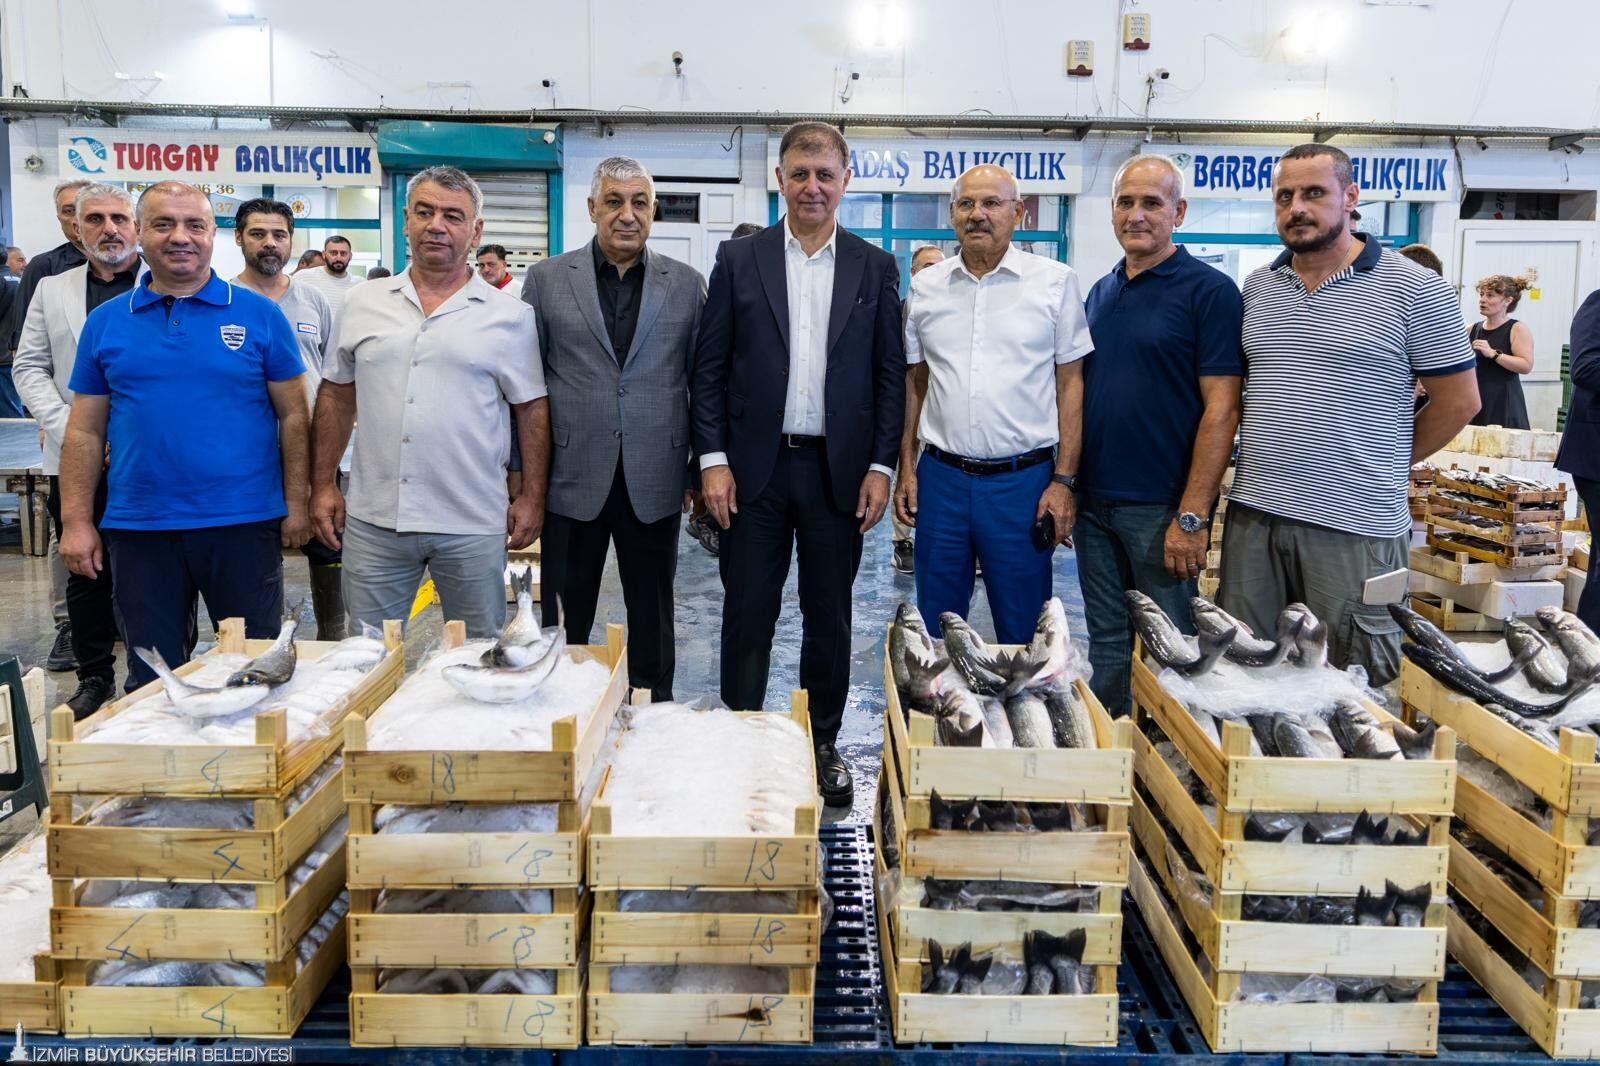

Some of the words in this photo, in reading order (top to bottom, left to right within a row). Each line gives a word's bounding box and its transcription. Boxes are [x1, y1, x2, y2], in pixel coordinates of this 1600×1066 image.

[113, 143, 219, 172] TURGAY
[235, 145, 371, 180] BALIKÇILIK
[850, 150, 909, 186] ADAŞ
[1194, 155, 1280, 191] BARBA
[1352, 158, 1447, 198] LIKÇILIK
[215, 201, 234, 214] 37
[216, 184, 234, 195] 36
[744, 838, 783, 882] 18
[748, 916, 786, 954] 18
[504, 996, 556, 1037] 18
